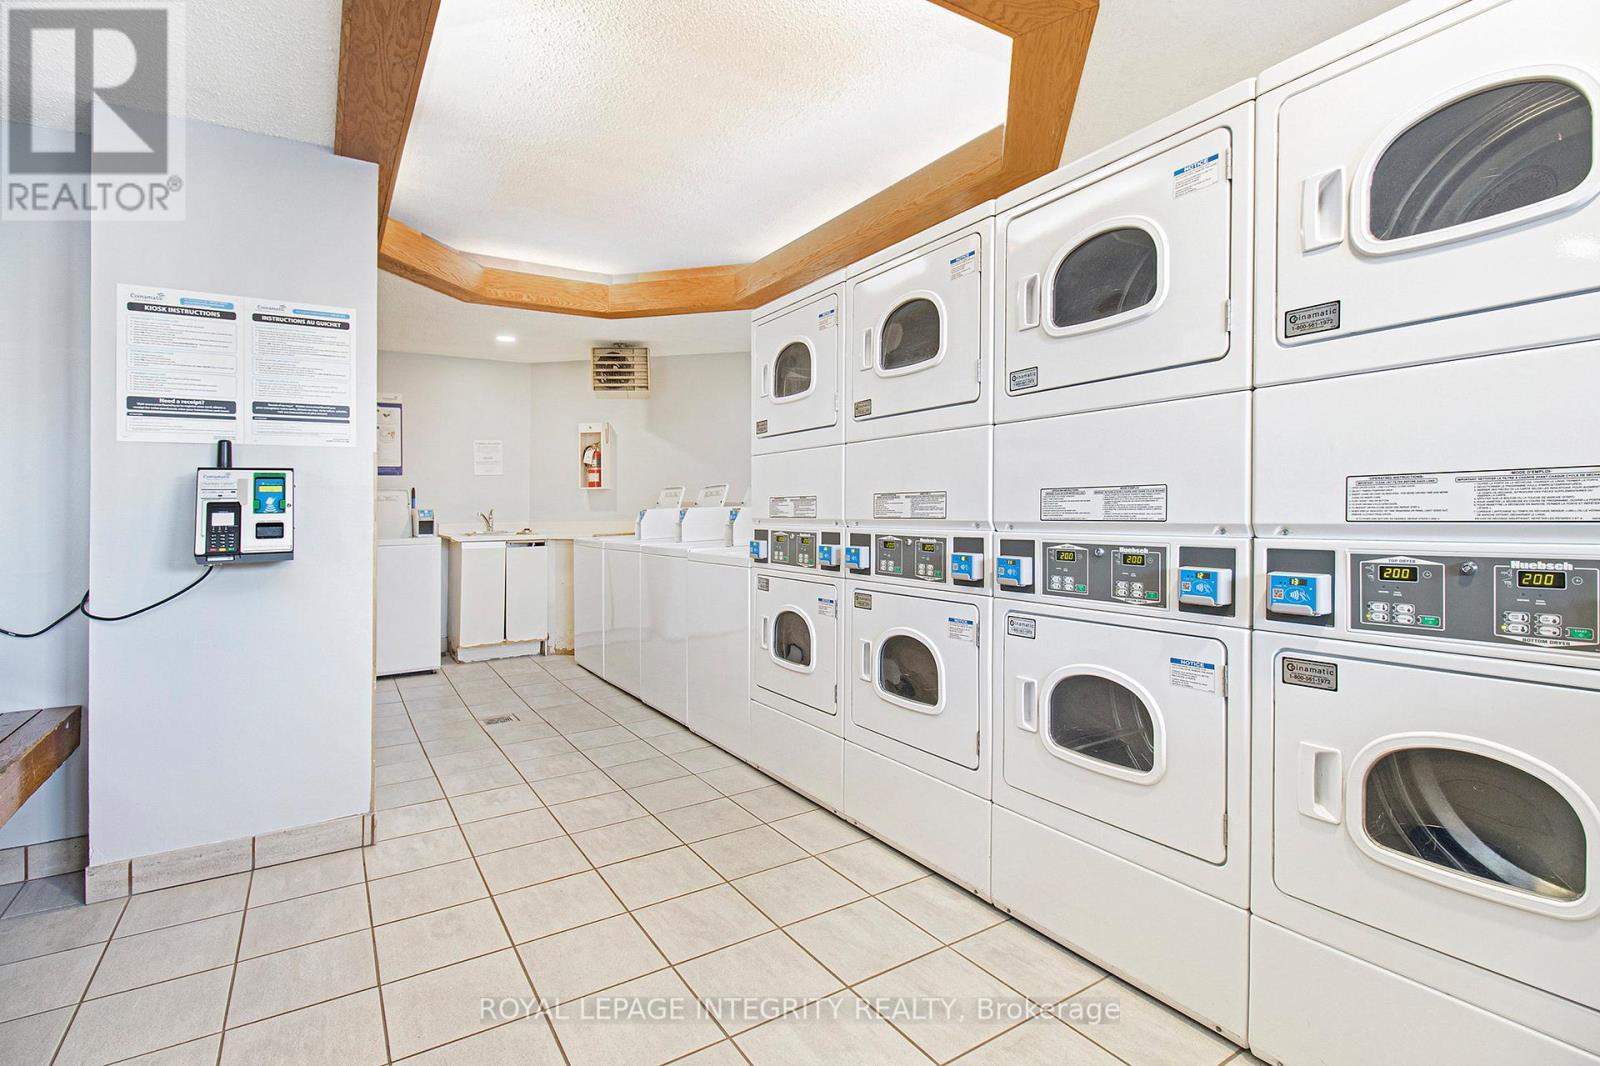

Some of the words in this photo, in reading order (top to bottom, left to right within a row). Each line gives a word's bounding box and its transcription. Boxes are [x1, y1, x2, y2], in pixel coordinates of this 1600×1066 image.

[144, 304, 168, 313] KIOSK
[168, 307, 221, 318] INSTRUCTIONS
[262, 315, 306, 325] INSTRUCTIONS
[316, 320, 342, 328] GUICHET
[1060, 552, 1074, 560] 200
[1126, 556, 1142, 564] 200
[1510, 560, 1574, 570] Huebsch
[1384, 568, 1410, 579] 200
[1522, 573, 1554, 586] 200
[1180, 659, 1204, 668] NOTICE
